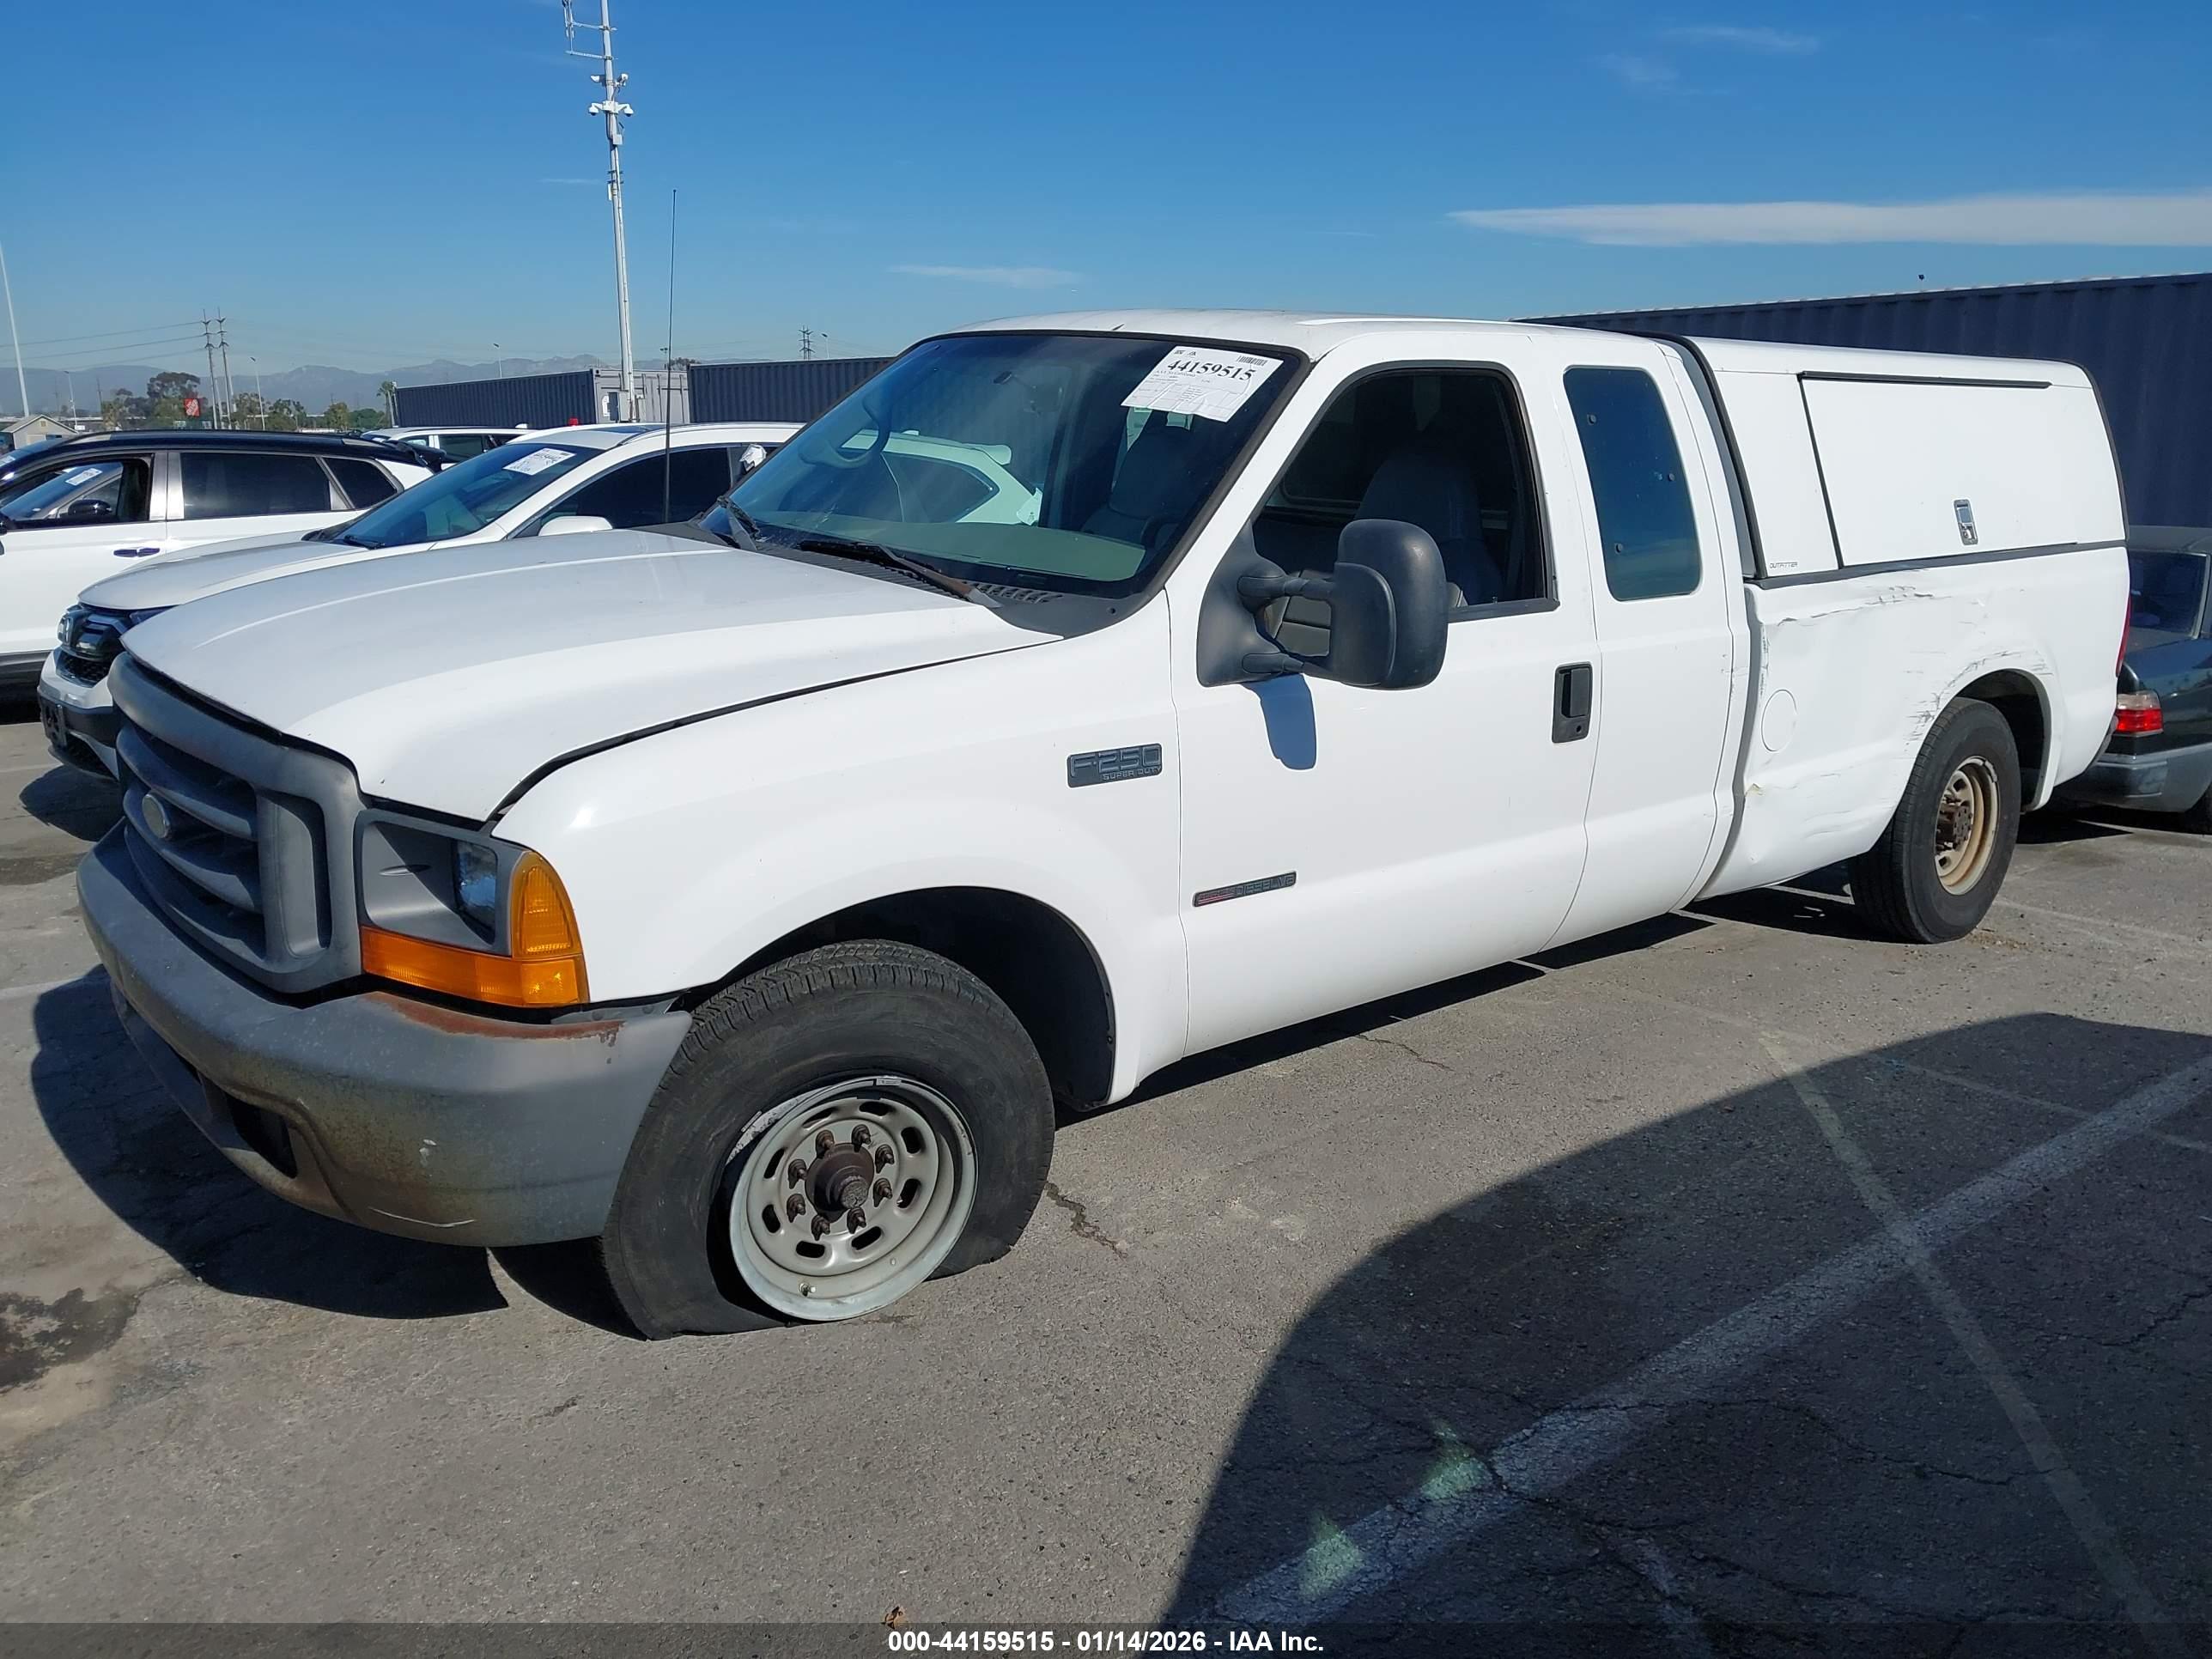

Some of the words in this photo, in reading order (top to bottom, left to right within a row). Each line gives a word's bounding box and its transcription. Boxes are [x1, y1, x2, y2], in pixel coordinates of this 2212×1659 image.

[1167, 359, 1257, 381] 44159515
[1102, 769, 1135, 781] SUPER
[1137, 767, 1162, 775] DUTY
